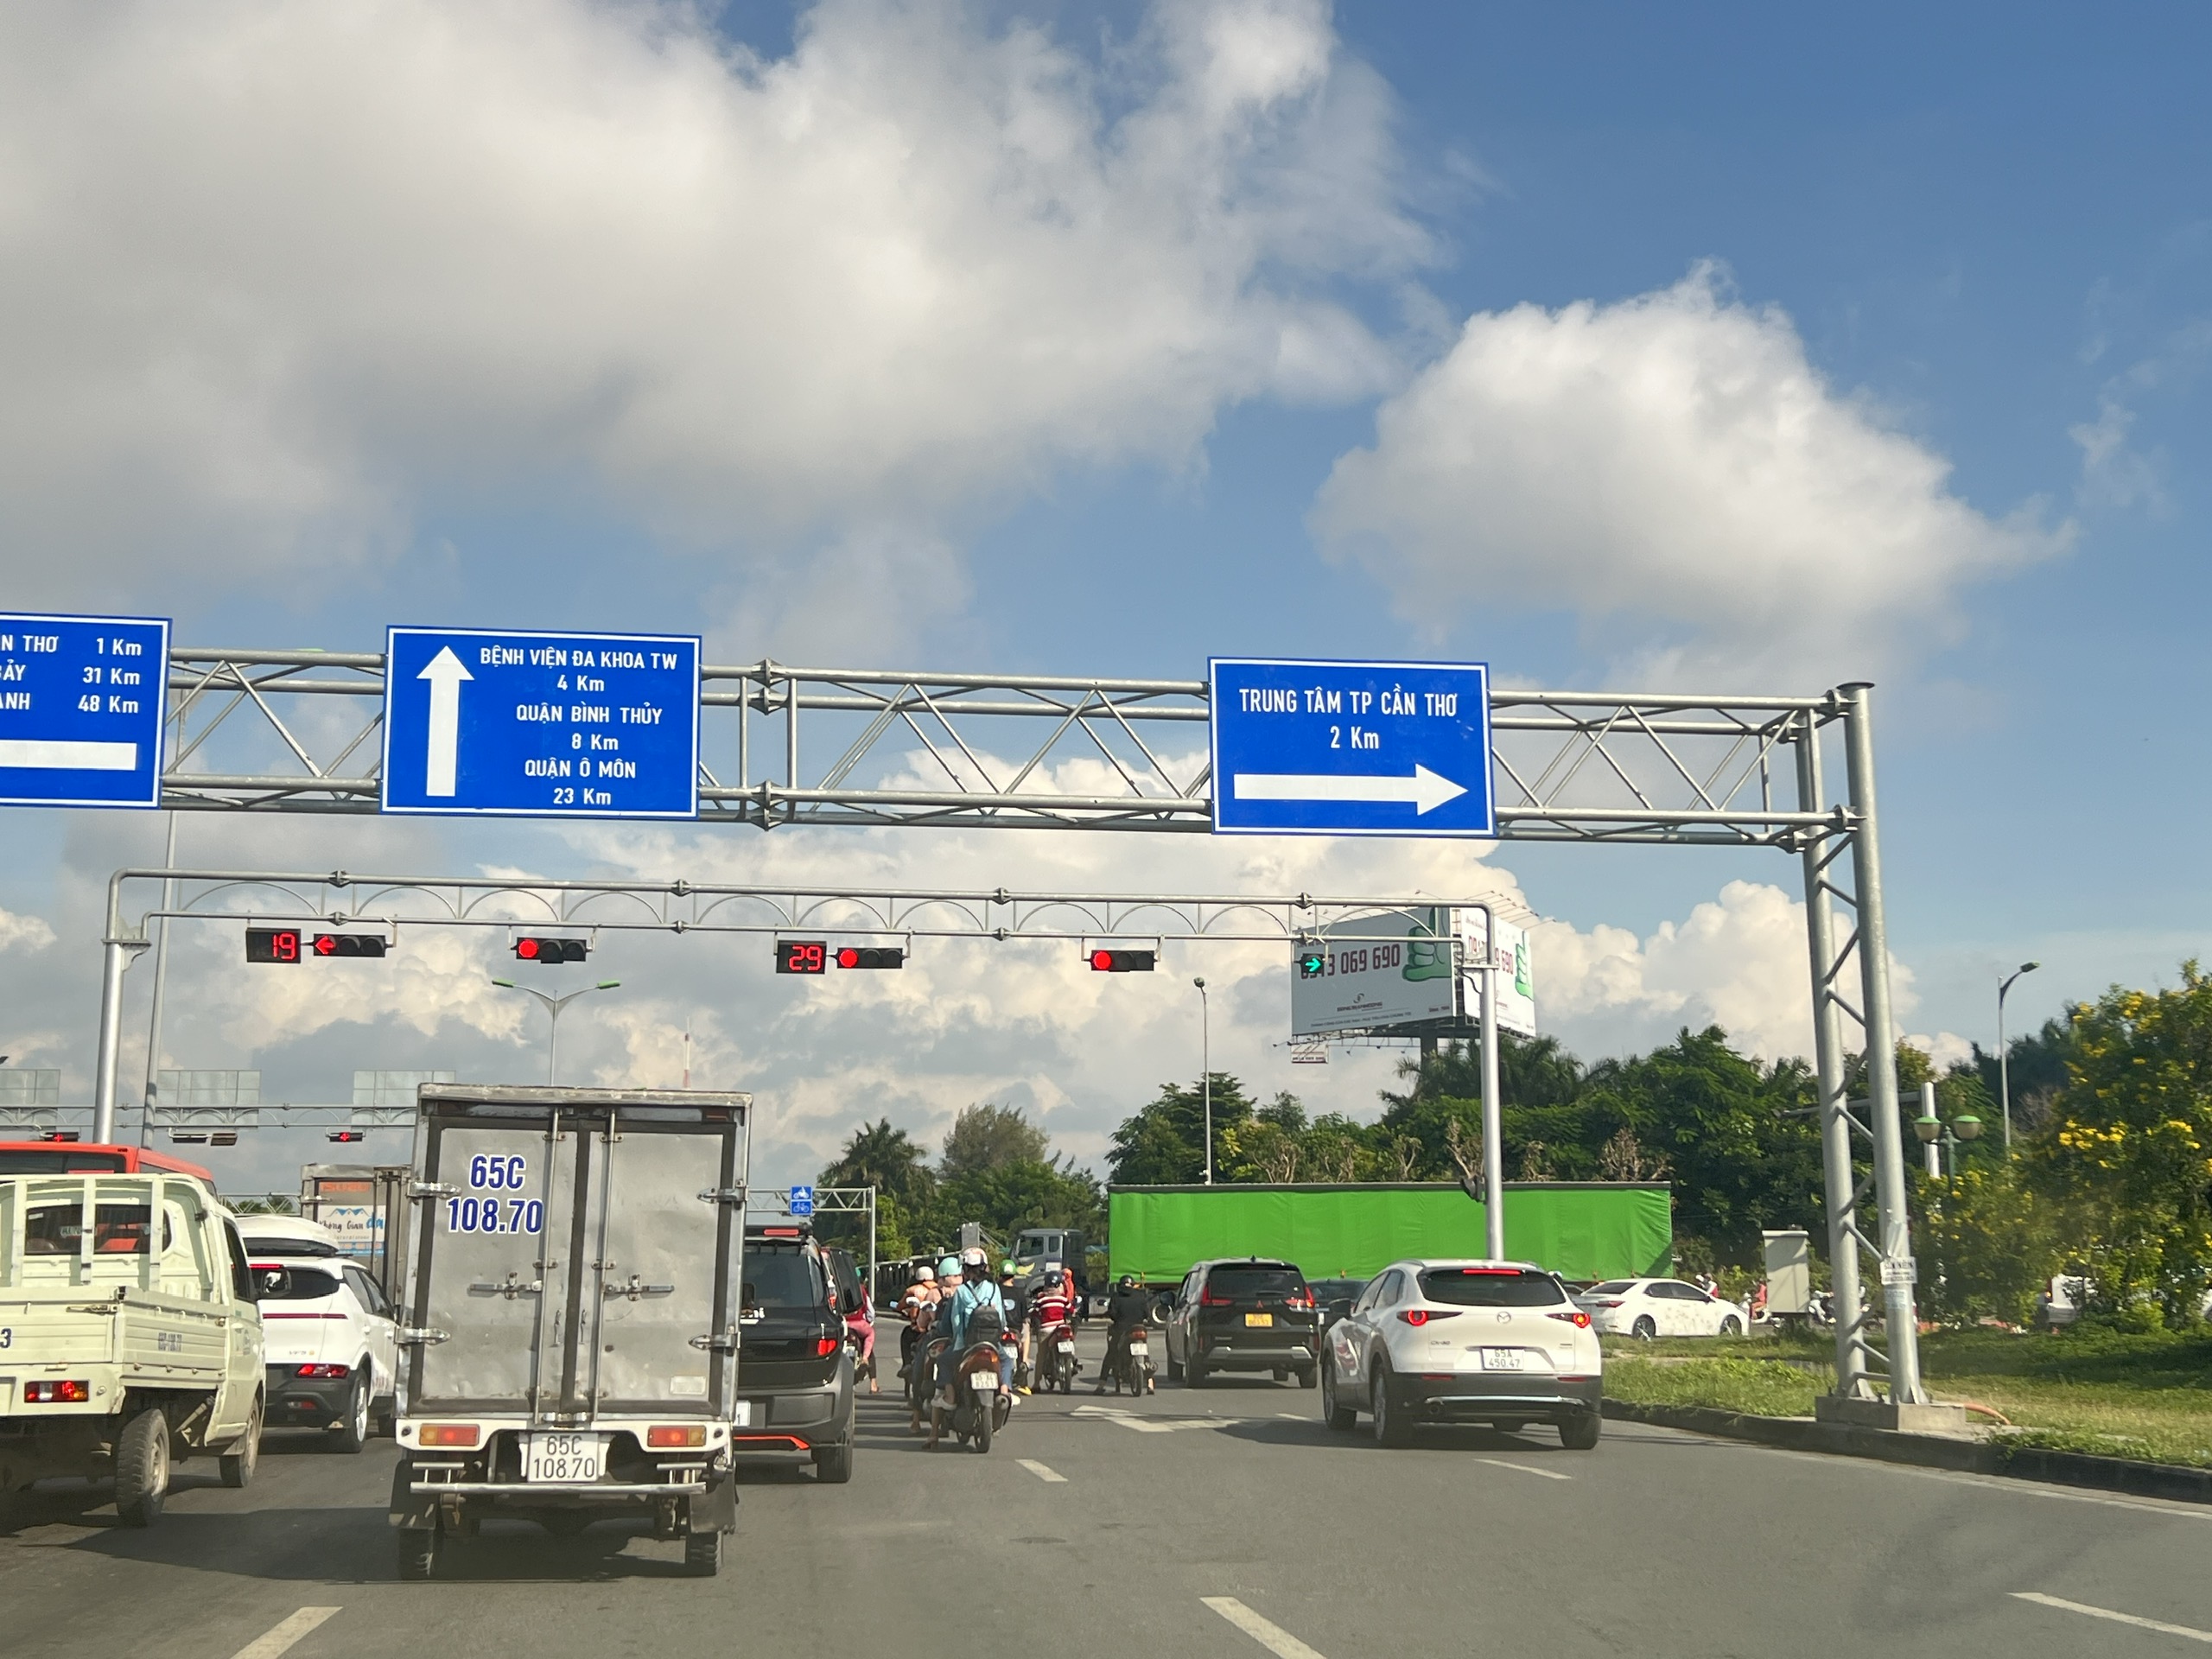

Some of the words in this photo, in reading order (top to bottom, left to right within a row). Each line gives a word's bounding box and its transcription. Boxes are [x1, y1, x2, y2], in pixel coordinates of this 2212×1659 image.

[22, 635, 59, 652] THƠ
[96, 638, 105, 654] 1
[111, 639, 143, 656] Km
[480, 645, 524, 668] BỆNH
[530, 646, 567, 670] VIỆN
[572, 651, 595, 667] ĐA
[601, 652, 645, 669] KHOA
[651, 652, 677, 670] TW
[0, 658, 27, 682] ẢY
[82, 666, 101, 683] 31
[110, 668, 140, 685] Km
[557, 674, 568, 690] 4
[577, 675, 605, 691] Km
[78, 695, 101, 712] 48
[108, 696, 138, 714] Km
[1238, 689, 1297, 713] TRUNG
[1304, 686, 1341, 714] TÂM
[1349, 690, 1372, 714] TP
[1381, 683, 1416, 715] CẦN
[1424, 693, 1458, 716] THƠ
[517, 702, 563, 724] QUẬN
[571, 701, 610, 723] BÌNH
[620, 702, 663, 725] THỦY
[571, 733, 582, 749] 8
[591, 734, 619, 750] Km
[1330, 726, 1340, 749] 2
[1351, 727, 1379, 749] Km
[524, 757, 570, 779] QUẬN
[579, 757, 591, 778] Ô
[599, 759, 636, 779] MÔN
[553, 787, 574, 804] 23
[583, 788, 611, 805] Km
[273, 932, 296, 960] 19
[789, 945, 823, 971] 29
[1341, 950, 1367, 975] 069
[1372, 944, 1401, 969] 690
[470, 1154, 525, 1191] 65C
[448, 1198, 543, 1233] 108.70
[547, 1435, 582, 1455] 65C
[534, 1458, 595, 1478] 108.70
